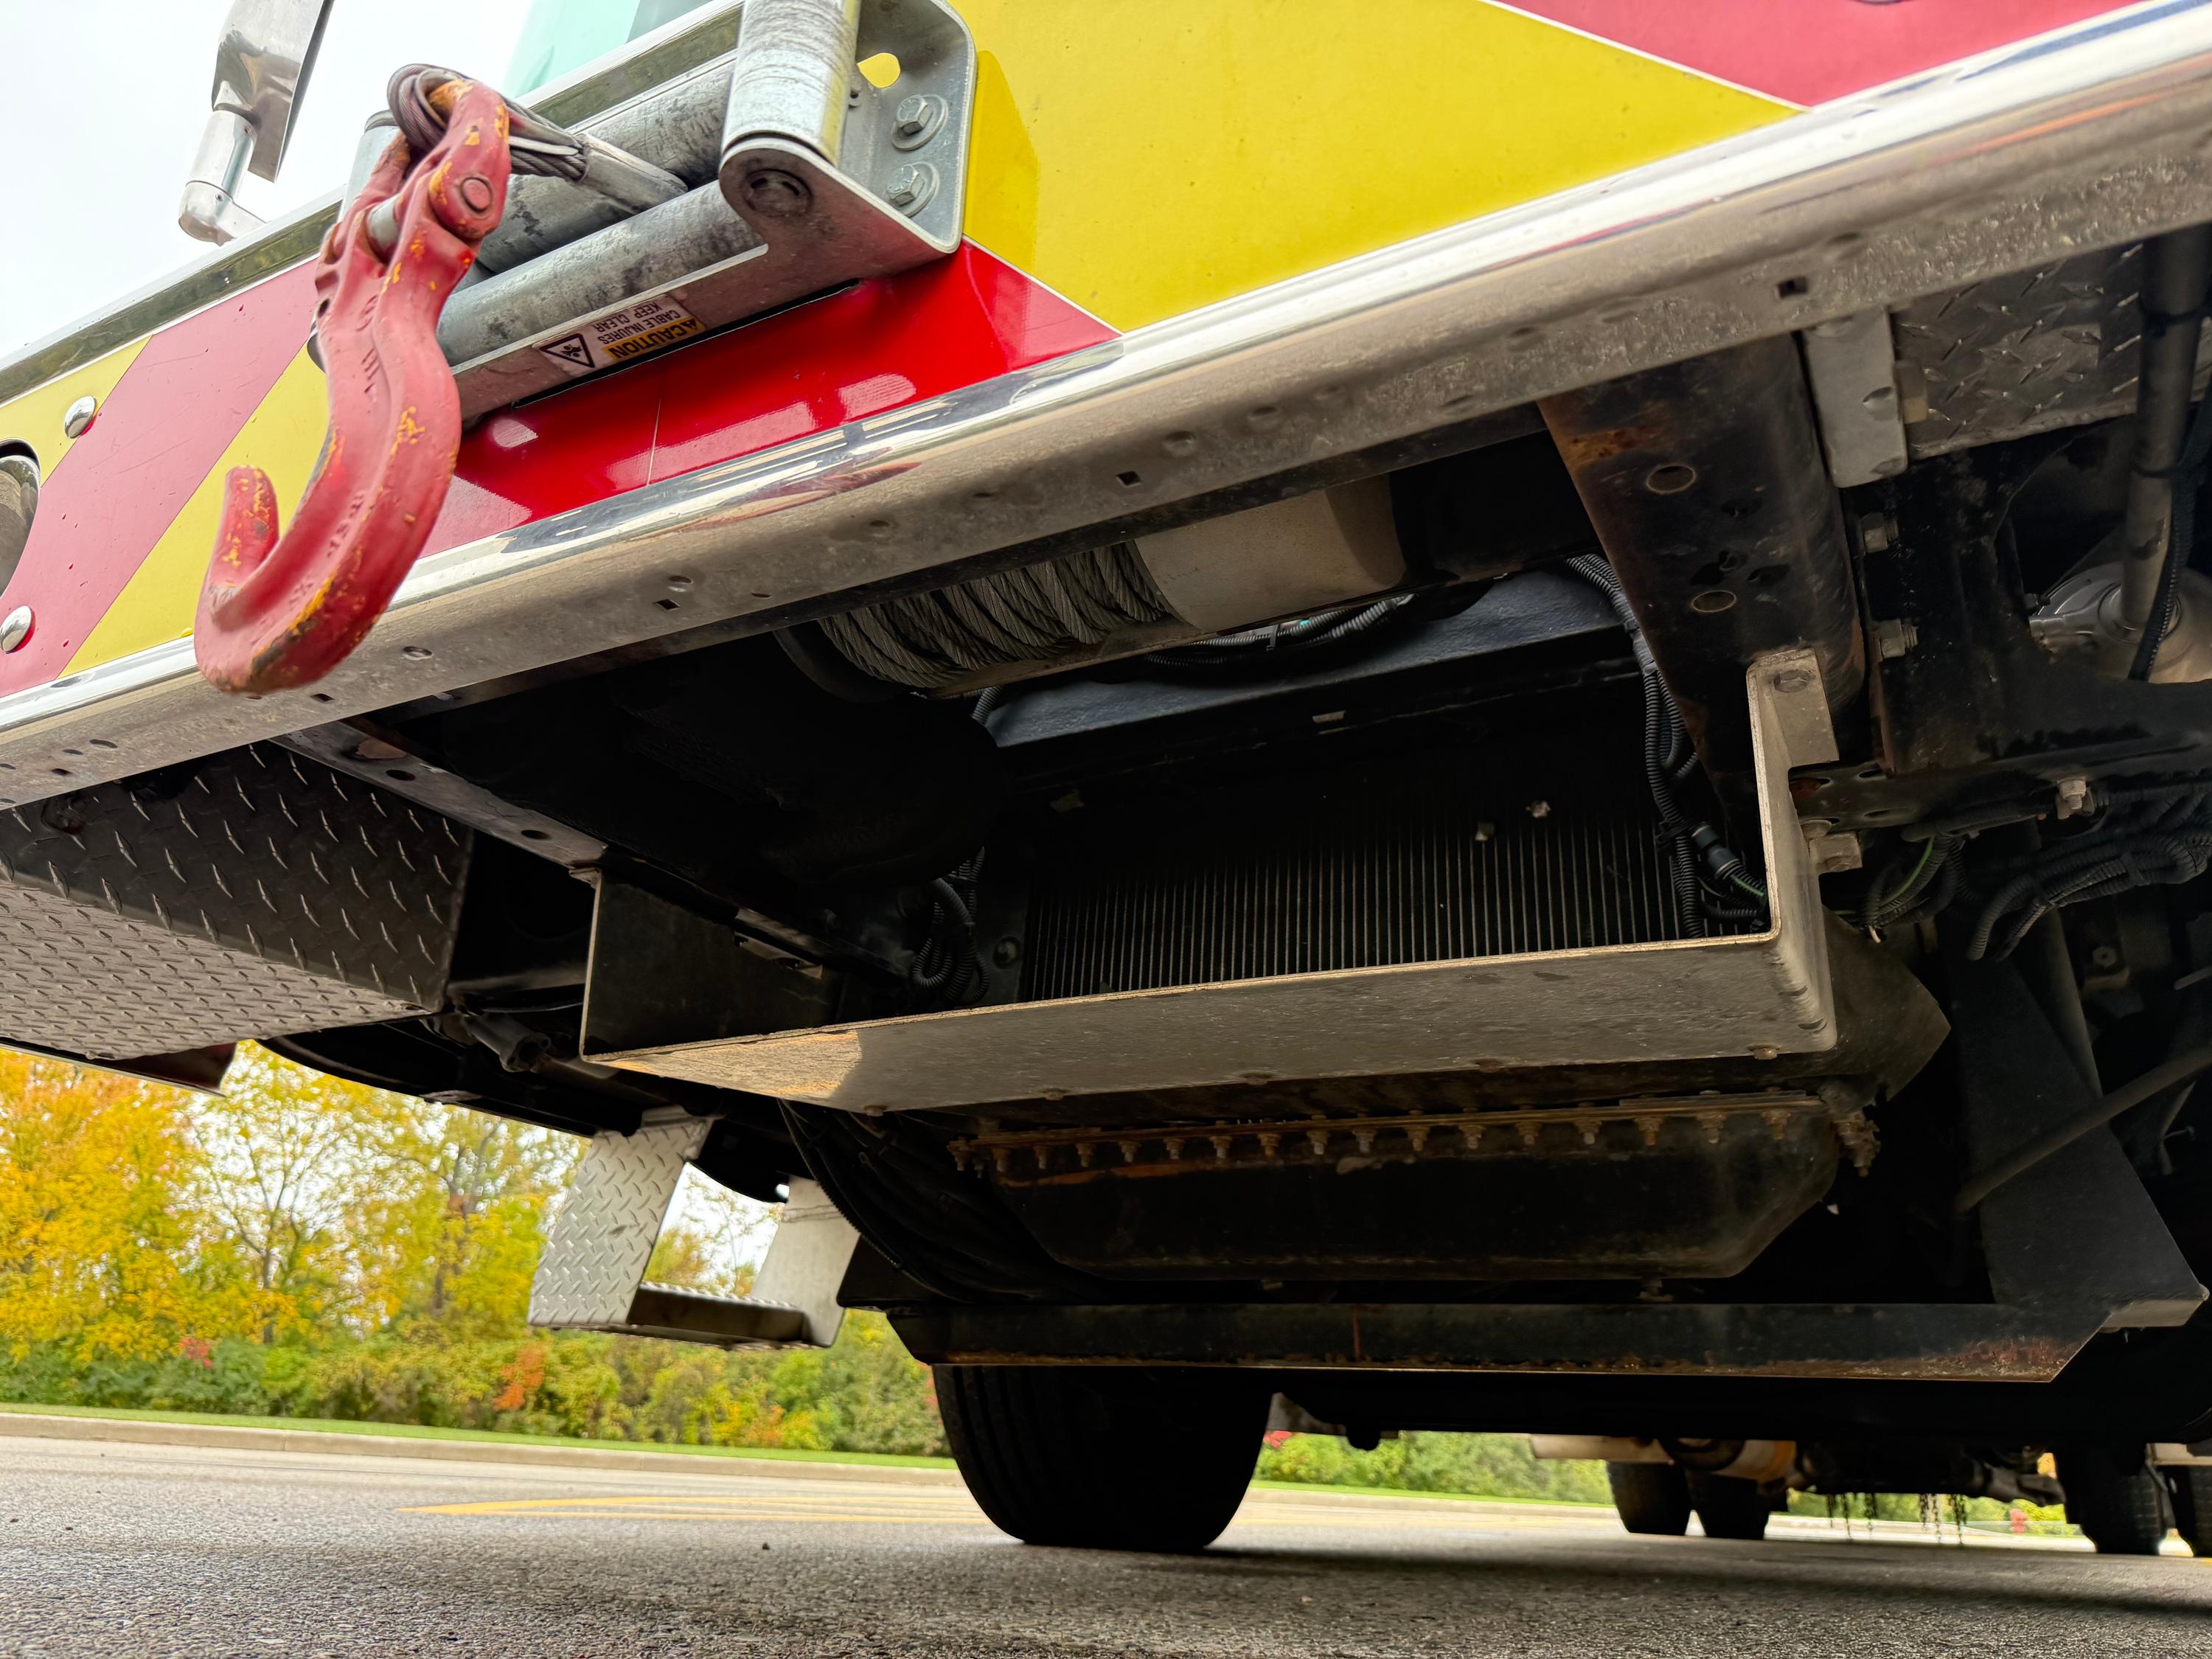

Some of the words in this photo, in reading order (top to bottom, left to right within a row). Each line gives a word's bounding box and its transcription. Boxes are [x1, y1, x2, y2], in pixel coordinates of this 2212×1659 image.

[634, 302, 664, 319] KEEP
[647, 310, 681, 328] CABLE
[593, 315, 630, 333] CLEAR
[597, 321, 644, 344] INJURES
[608, 325, 687, 358] CAUTION
